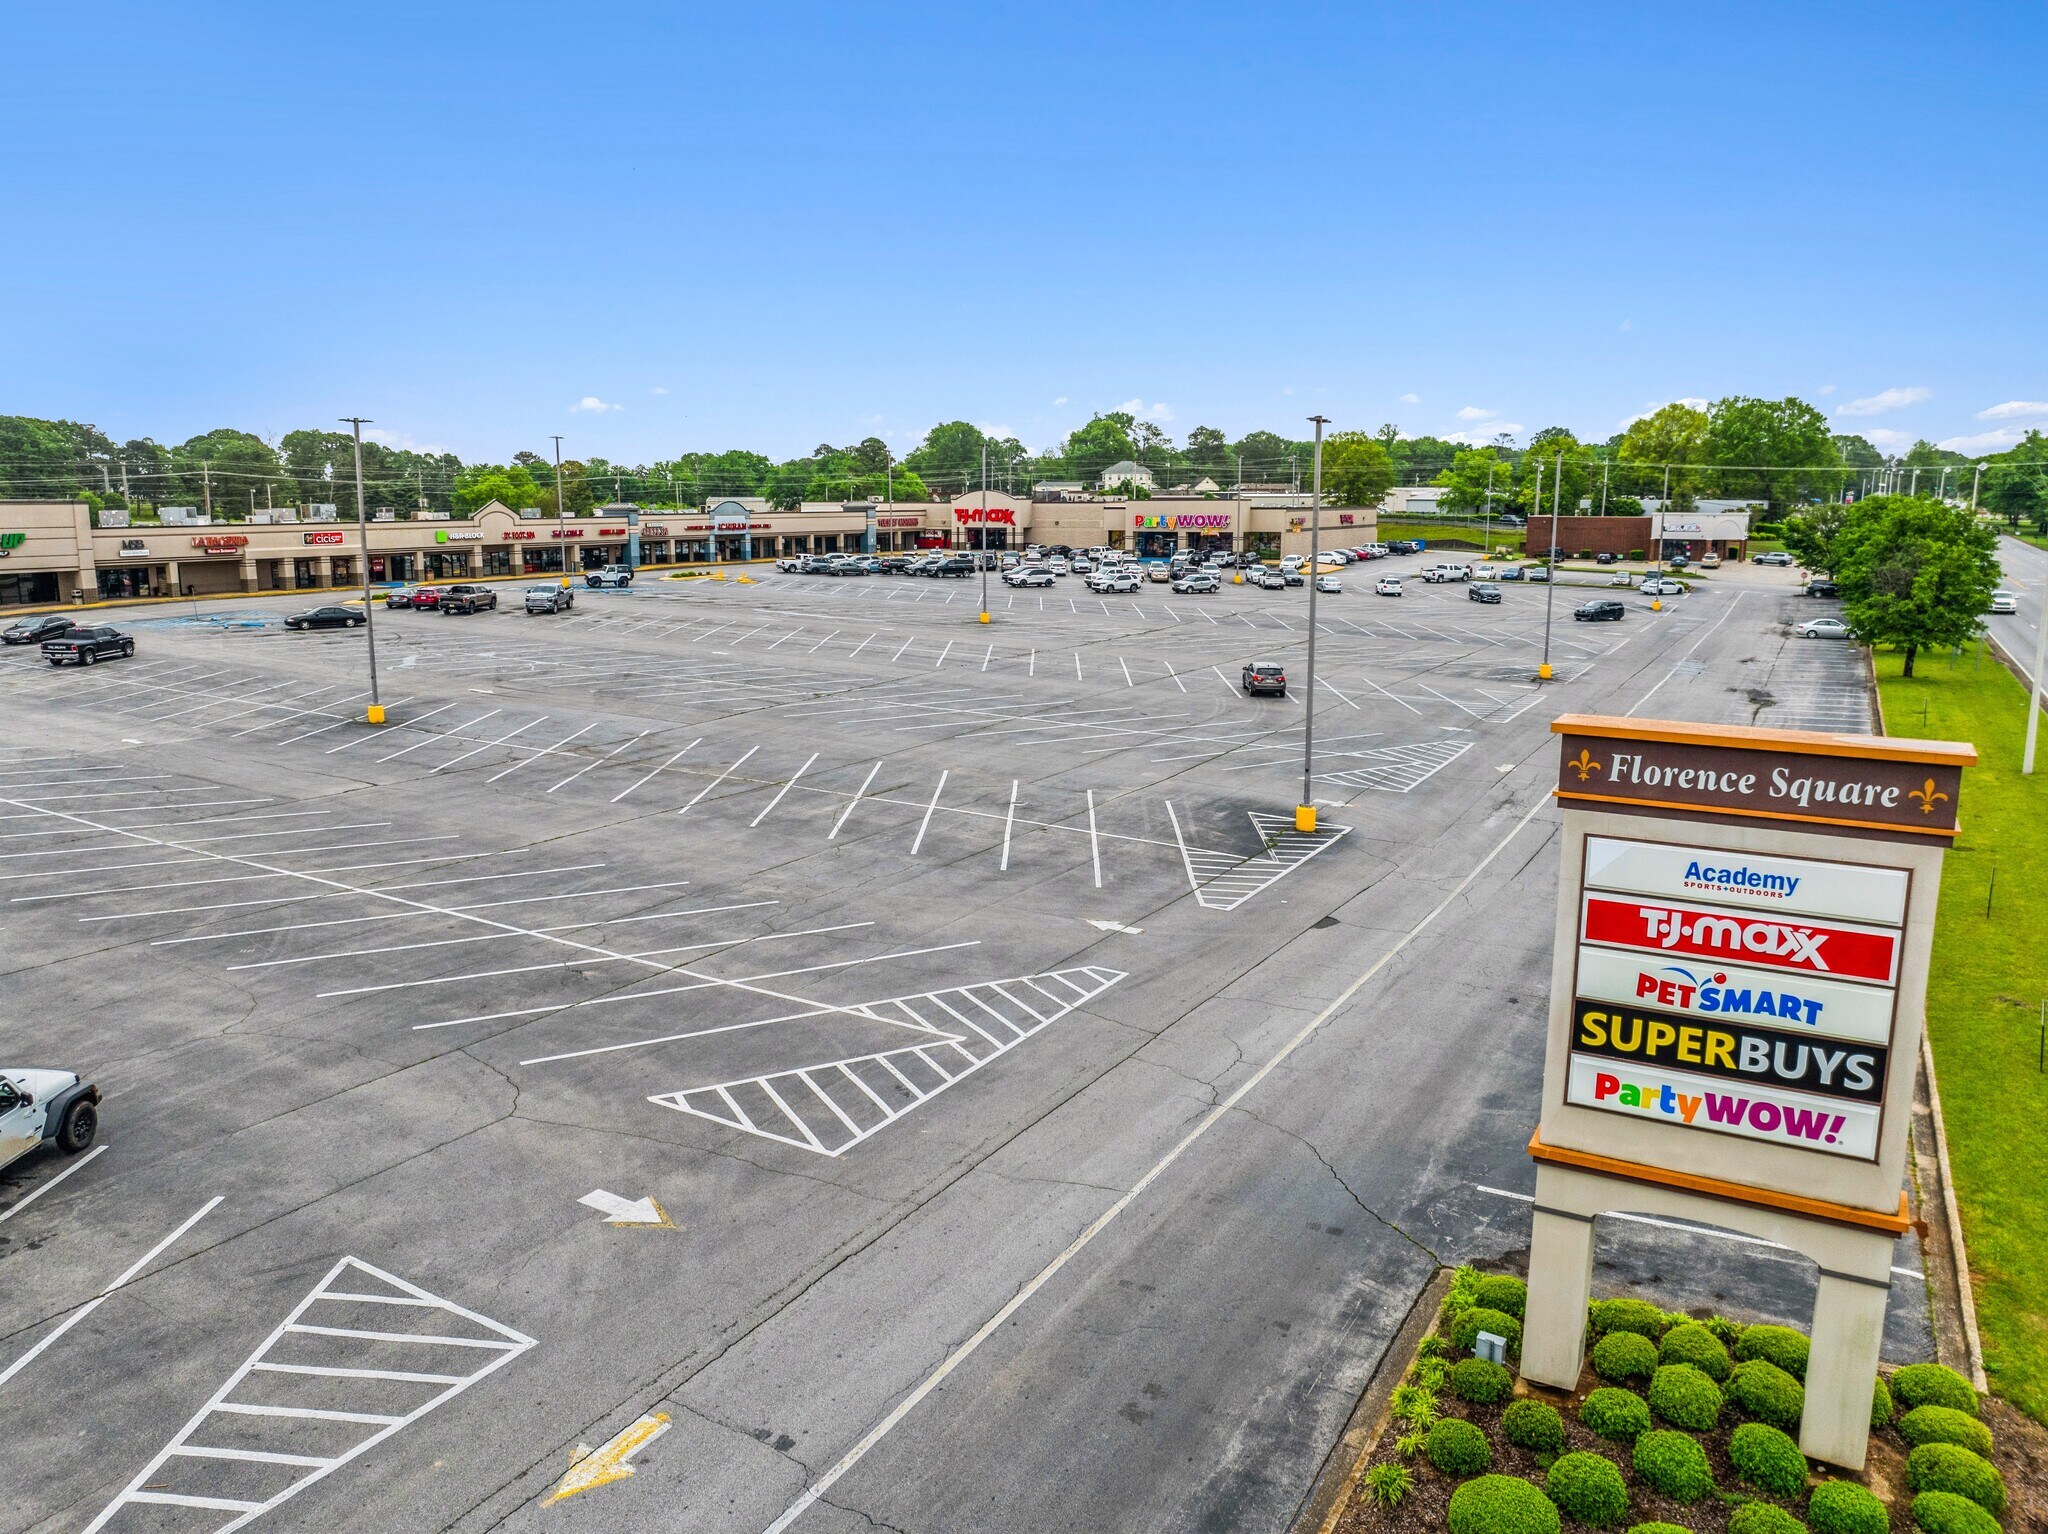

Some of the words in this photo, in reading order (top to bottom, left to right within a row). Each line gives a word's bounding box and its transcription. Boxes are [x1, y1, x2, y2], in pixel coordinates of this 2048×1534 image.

[1608, 753, 1756, 795] Florence
[1769, 767, 1901, 808] Square
[1684, 861, 1800, 897] Academy
